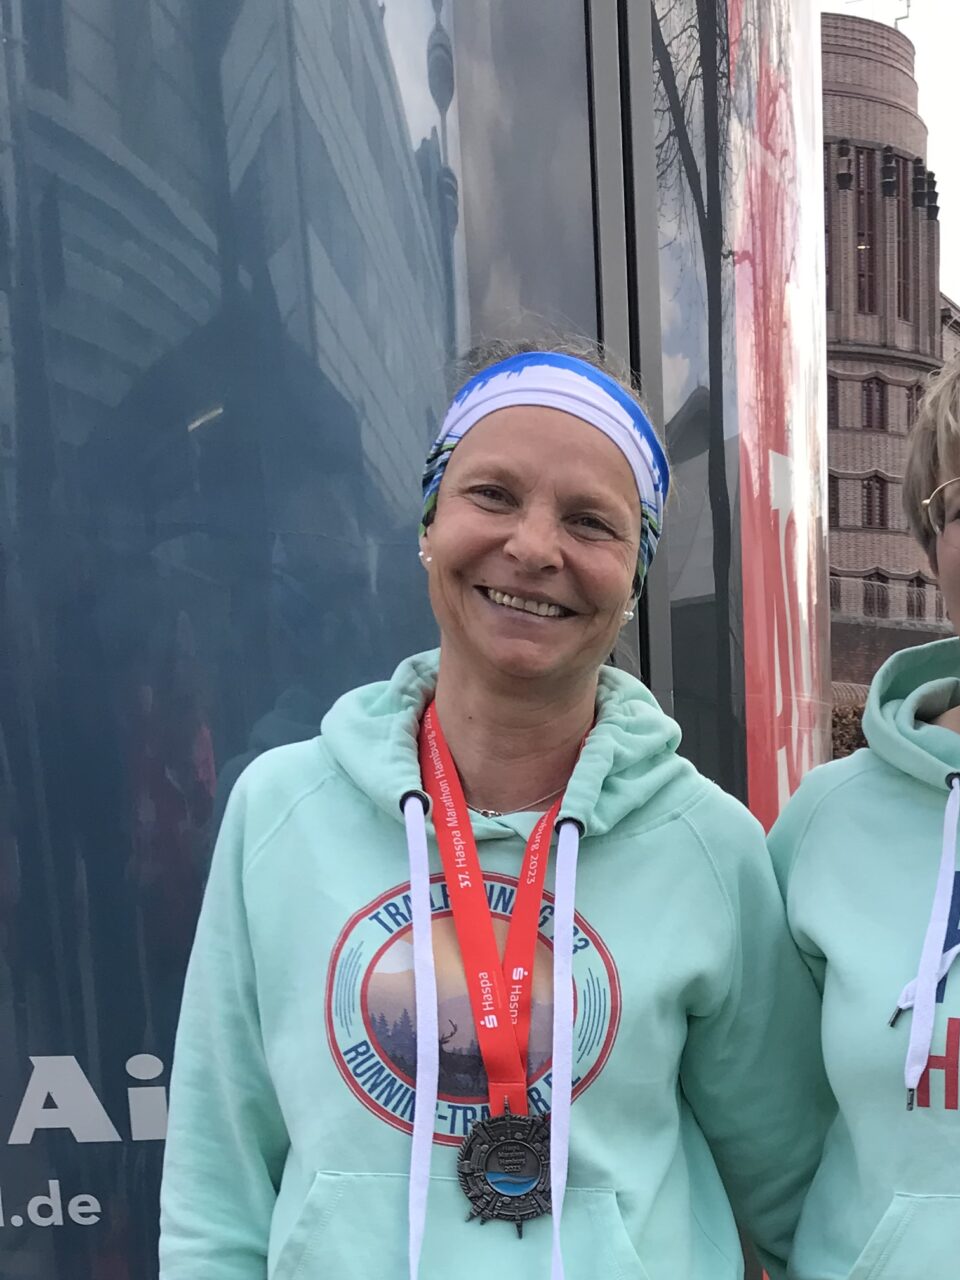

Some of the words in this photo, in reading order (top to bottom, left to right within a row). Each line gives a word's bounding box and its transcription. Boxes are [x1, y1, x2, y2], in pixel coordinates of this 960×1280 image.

[427, 731, 446, 779] Hamburg
[439, 780, 459, 827] Marathon
[449, 830, 467, 868] Haspa
[527, 854, 539, 885] 2023
[479, 972, 494, 1011] Haspa
